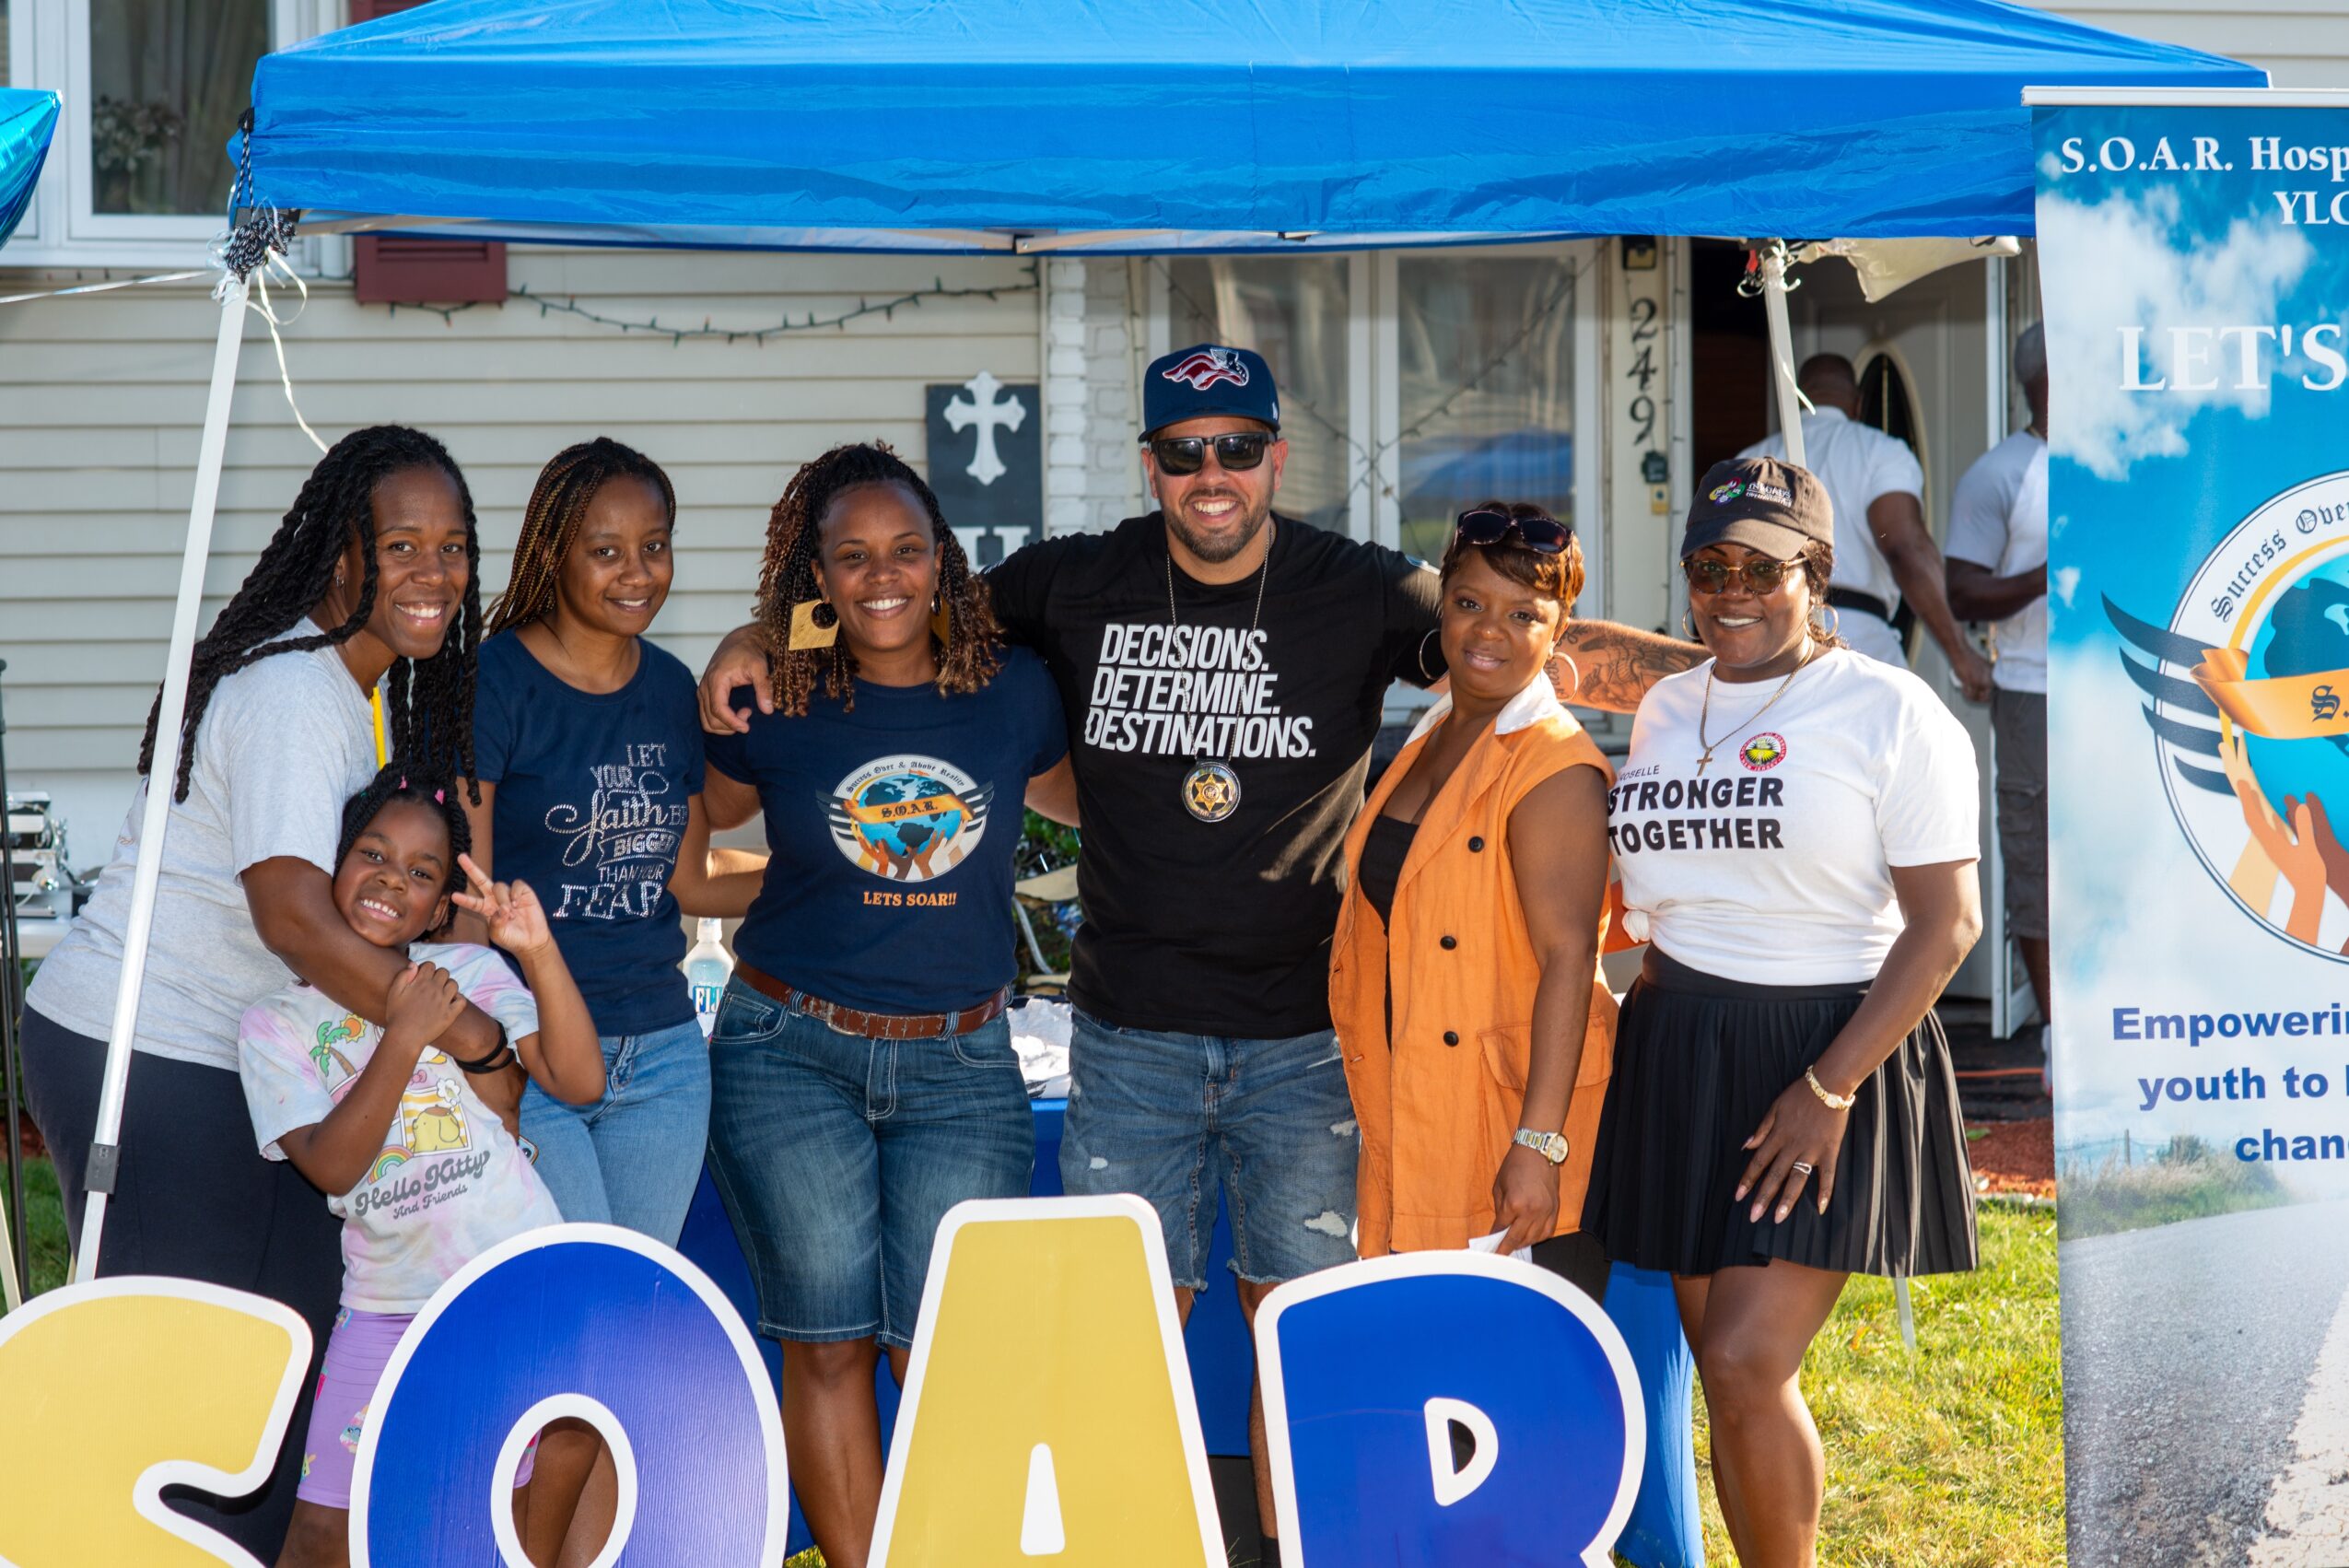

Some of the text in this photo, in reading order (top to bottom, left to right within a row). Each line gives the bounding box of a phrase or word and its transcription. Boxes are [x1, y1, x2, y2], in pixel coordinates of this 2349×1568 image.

[2062, 137, 2233, 172] S.O.A.R.
[1627, 297, 1658, 446] 249
[2117, 324, 2347, 391] LET'S
[2211, 529, 2286, 622] Success
[1099, 624, 1269, 672] DECISIONS.
[1090, 665, 1281, 715] DETERMINE.
[1084, 707, 1317, 758] DESTINATIONS.
[626, 743, 666, 766] LET
[590, 764, 637, 788] YOUR
[846, 771, 871, 793] Success
[873, 764, 894, 774] Over
[910, 761, 936, 771] Above
[940, 767, 964, 787] Reality
[882, 801, 938, 818] S.O.A.R.
[1607, 777, 1784, 816] STRONGER
[1607, 818, 1784, 857] TOGETHER
[598, 865, 638, 883] THAN
[863, 891, 957, 907] LETS SOAR!!
[2112, 1002, 2349, 1047] Empoweri
[2138, 1067, 2266, 1111] youth
[2283, 1066, 2329, 1099] to
[2236, 1129, 2349, 1162] chan
[355, 1151, 490, 1216] Hello Kitty
[392, 1184, 468, 1220] And Friends
